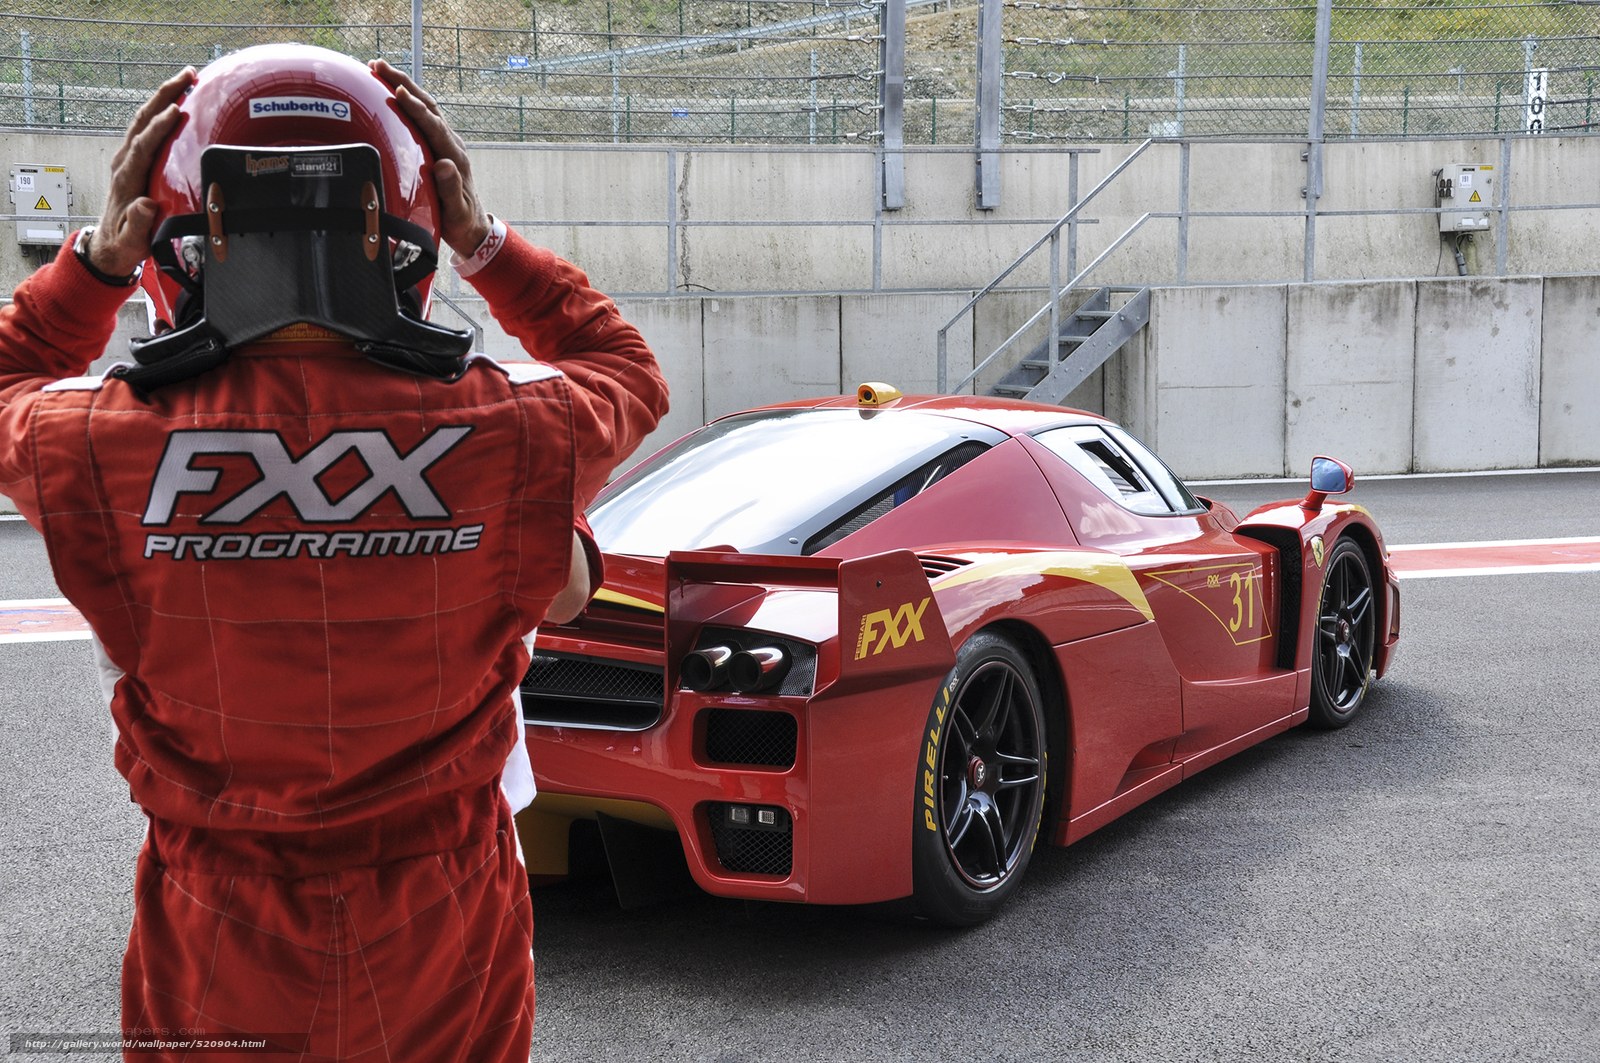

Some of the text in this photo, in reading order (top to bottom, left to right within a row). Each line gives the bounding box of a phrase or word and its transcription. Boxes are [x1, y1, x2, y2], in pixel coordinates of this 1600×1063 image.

[253, 101, 330, 113] Schuberth
[20, 176, 31, 185] 190
[295, 162, 337, 172] stand21
[475, 229, 499, 261] FXX
[141, 425, 476, 526] FXX
[143, 523, 485, 561] PROGRAMME
[1229, 571, 1253, 632] 31
[860, 597, 931, 659] FXX
[925, 687, 950, 832] PIRELLI
